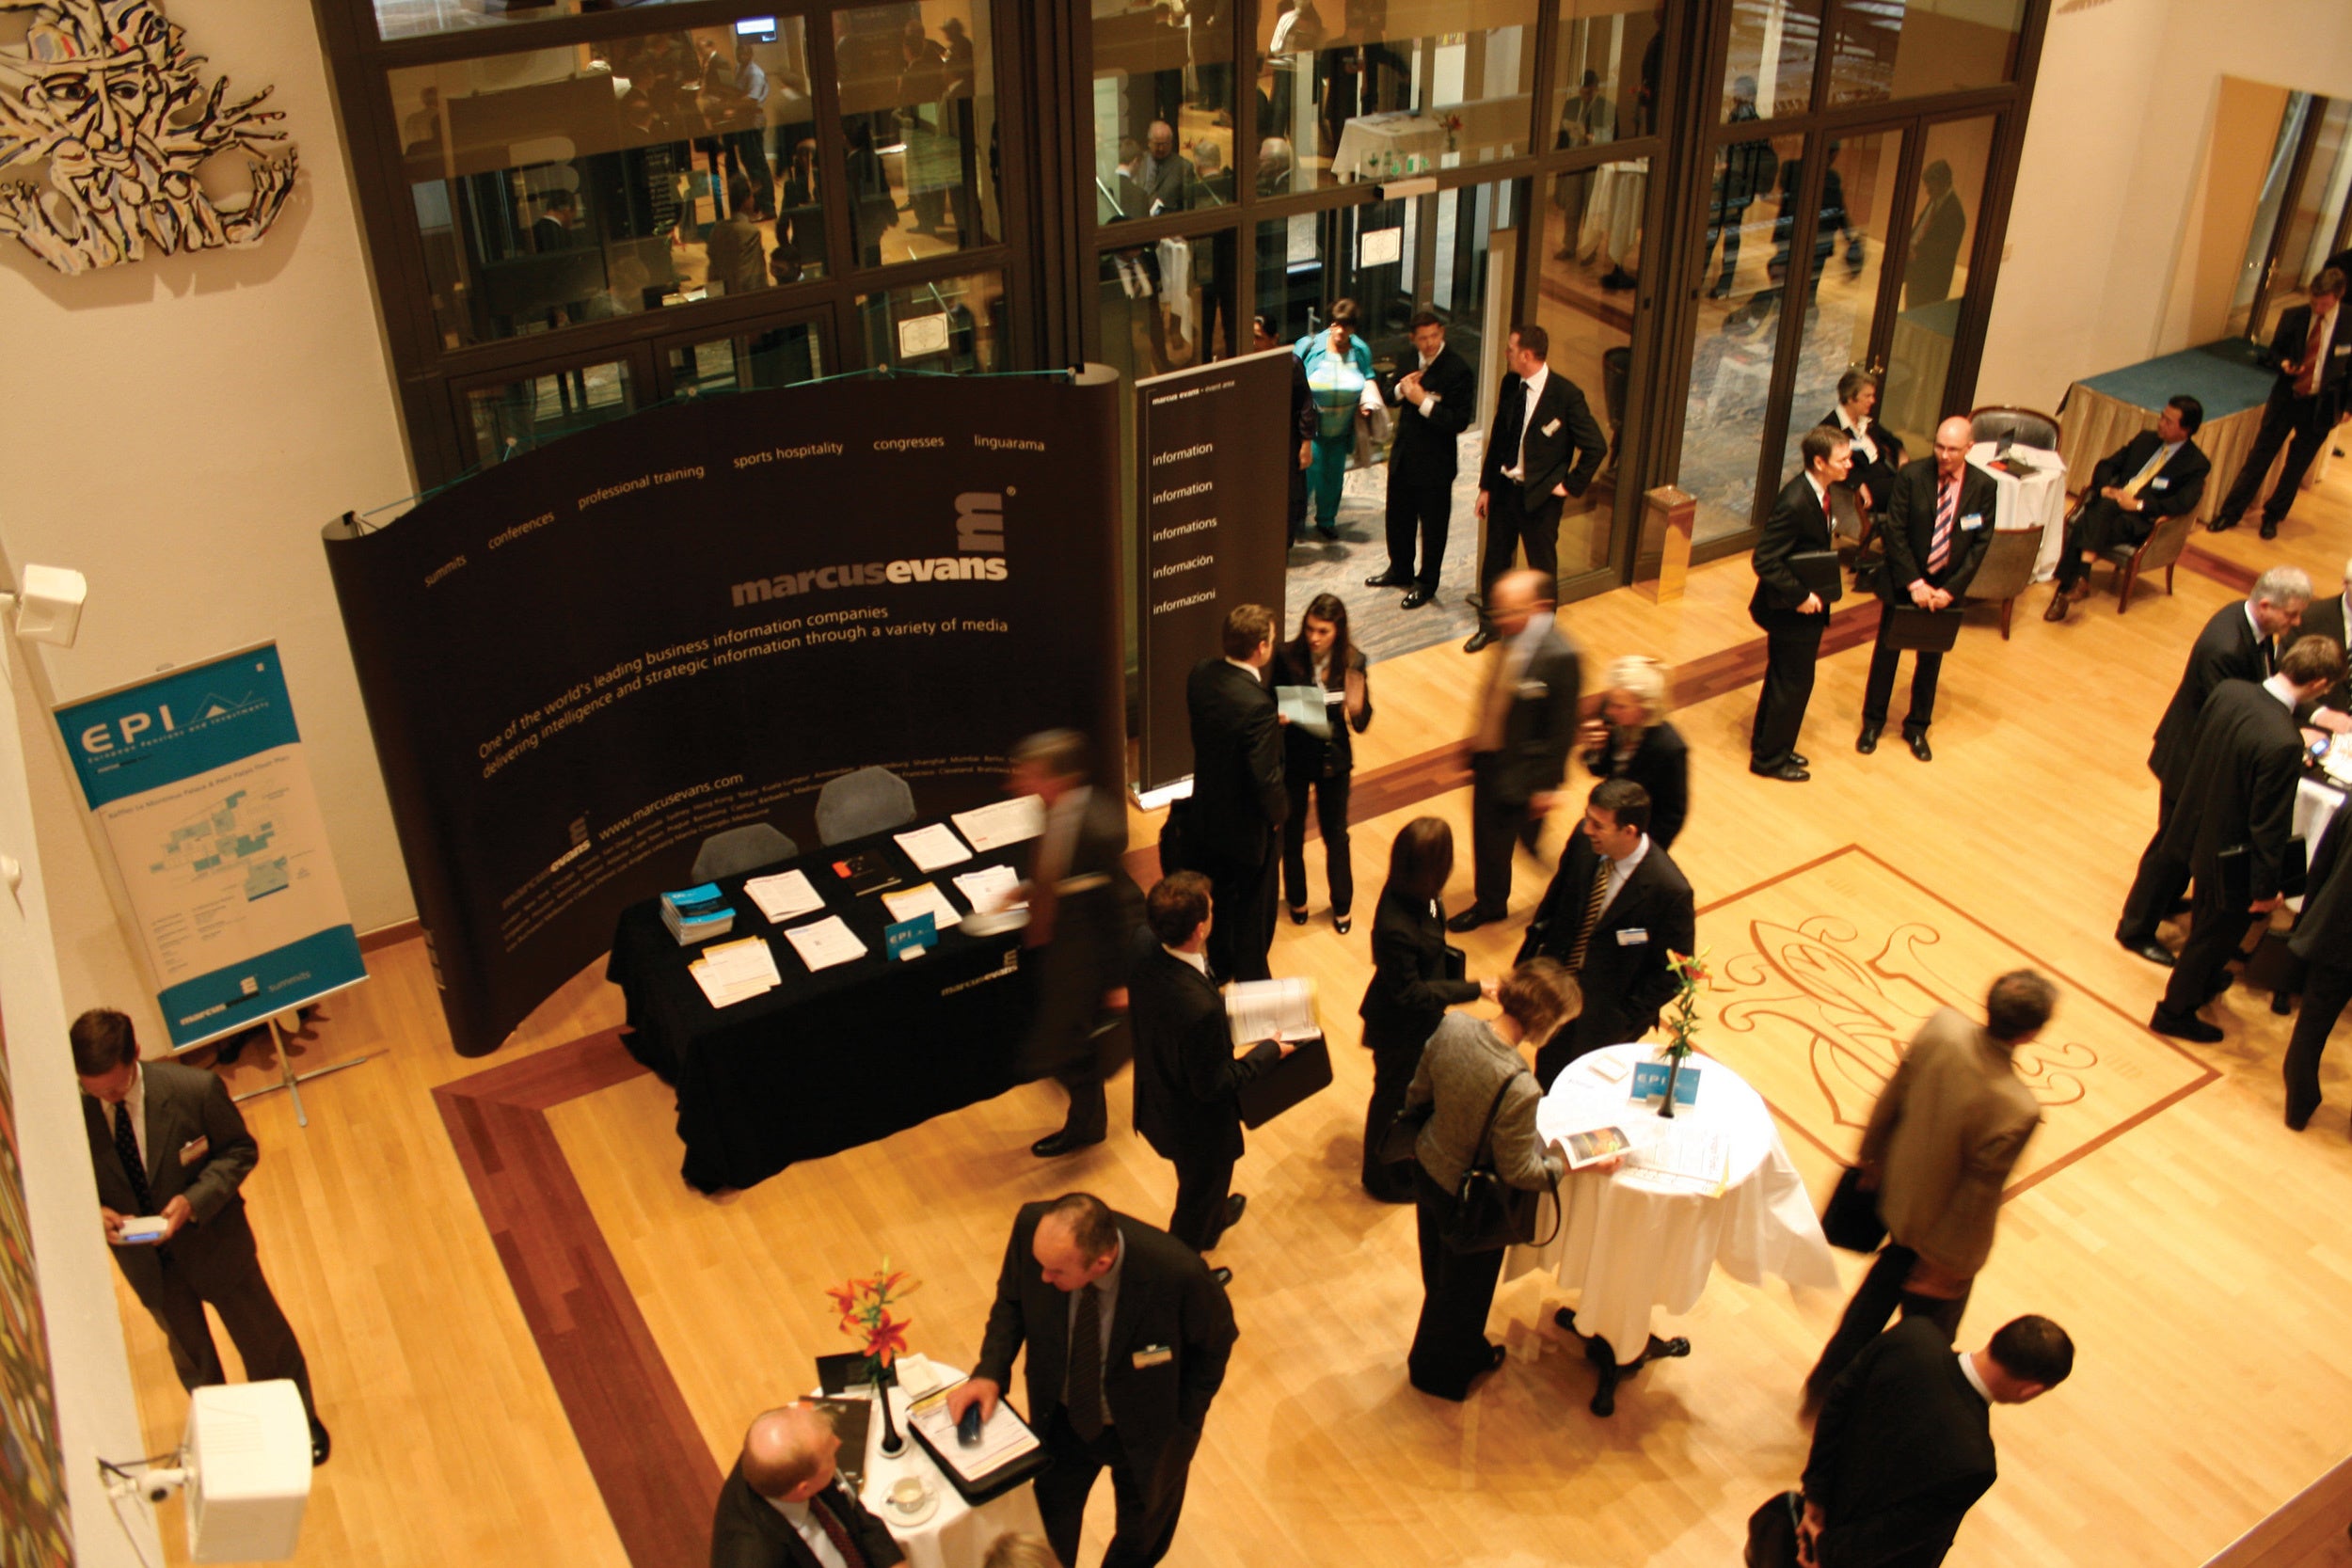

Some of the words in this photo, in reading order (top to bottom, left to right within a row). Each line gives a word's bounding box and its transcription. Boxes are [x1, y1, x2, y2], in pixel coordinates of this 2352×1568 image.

[1152, 442, 1213, 467] information
[424, 554, 467, 588] summits
[487, 511, 555, 549] conferences
[578, 474, 650, 511] professional
[653, 466, 705, 485] training
[733, 450, 772, 469] sports
[776, 441, 844, 459] hospitality
[873, 436, 945, 452] congresses
[974, 434, 1045, 451] linguarama
[1152, 481, 1213, 505] information
[1152, 517, 1217, 543] informations
[731, 556, 1009, 608] marcusevans
[1152, 588, 1216, 615] informazioni
[478, 735, 502, 759] One
[504, 720, 517, 740] of
[520, 709, 541, 730] the
[544, 683, 593, 715] world's
[594, 657, 643, 689] leading
[645, 638, 709, 666] business
[713, 617, 802, 648] information
[806, 605, 888, 627] companies
[483, 733, 539, 779] delivering
[541, 691, 612, 739] intelligence
[616, 675, 642, 699] and
[645, 657, 708, 687] strategic
[713, 636, 801, 667] information
[805, 625, 866, 646] through
[871, 626, 881, 637] a
[885, 619, 936, 636] variety
[941, 617, 958, 632] of
[962, 618, 1009, 632] media
[81, 704, 175, 753] EPI
[598, 773, 744, 841] www.marcusevans.com
